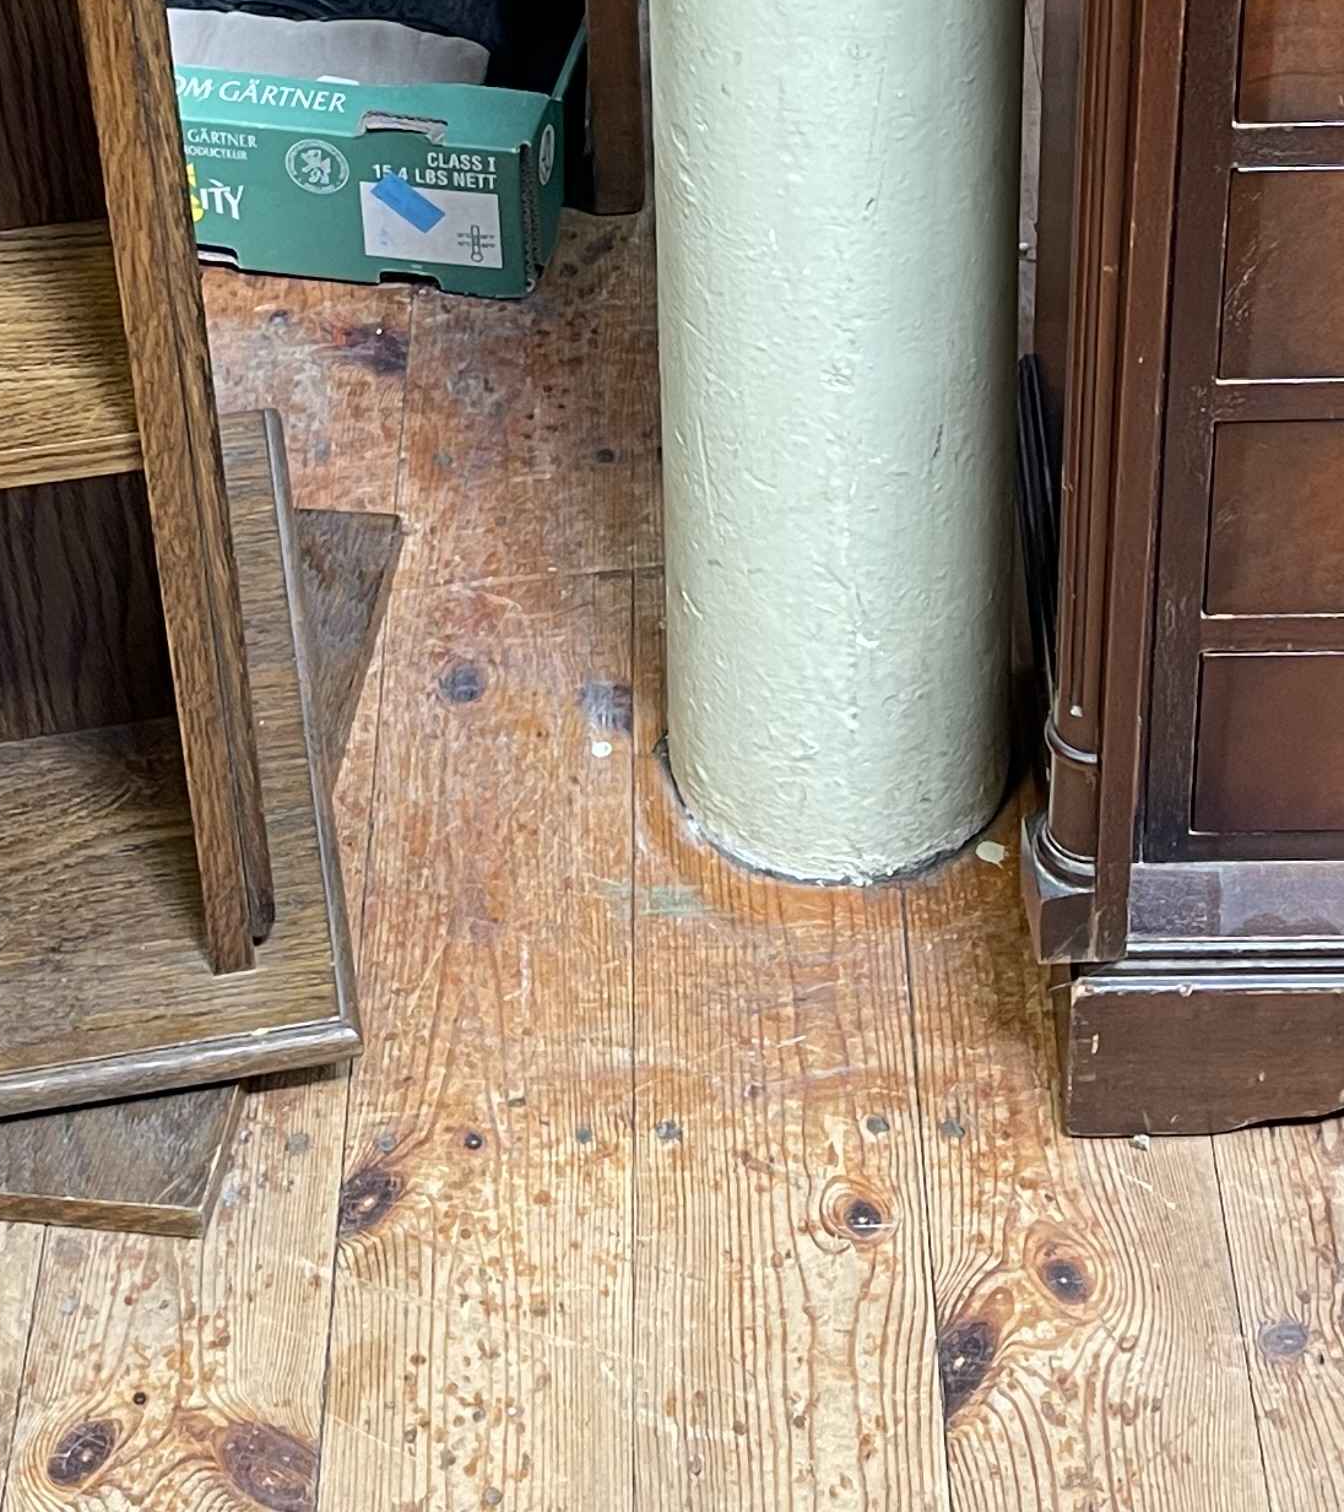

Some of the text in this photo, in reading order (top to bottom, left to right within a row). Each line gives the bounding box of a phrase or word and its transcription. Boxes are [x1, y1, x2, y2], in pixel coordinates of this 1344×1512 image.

[174, 75, 347, 114] OM GÄRTNER
[187, 128, 258, 148] GÄRTNER
[426, 151, 497, 173] CLASS I
[415, 167, 449, 187] LBS
[453, 172, 497, 190] NETT
[199, 178, 244, 220] ITY
